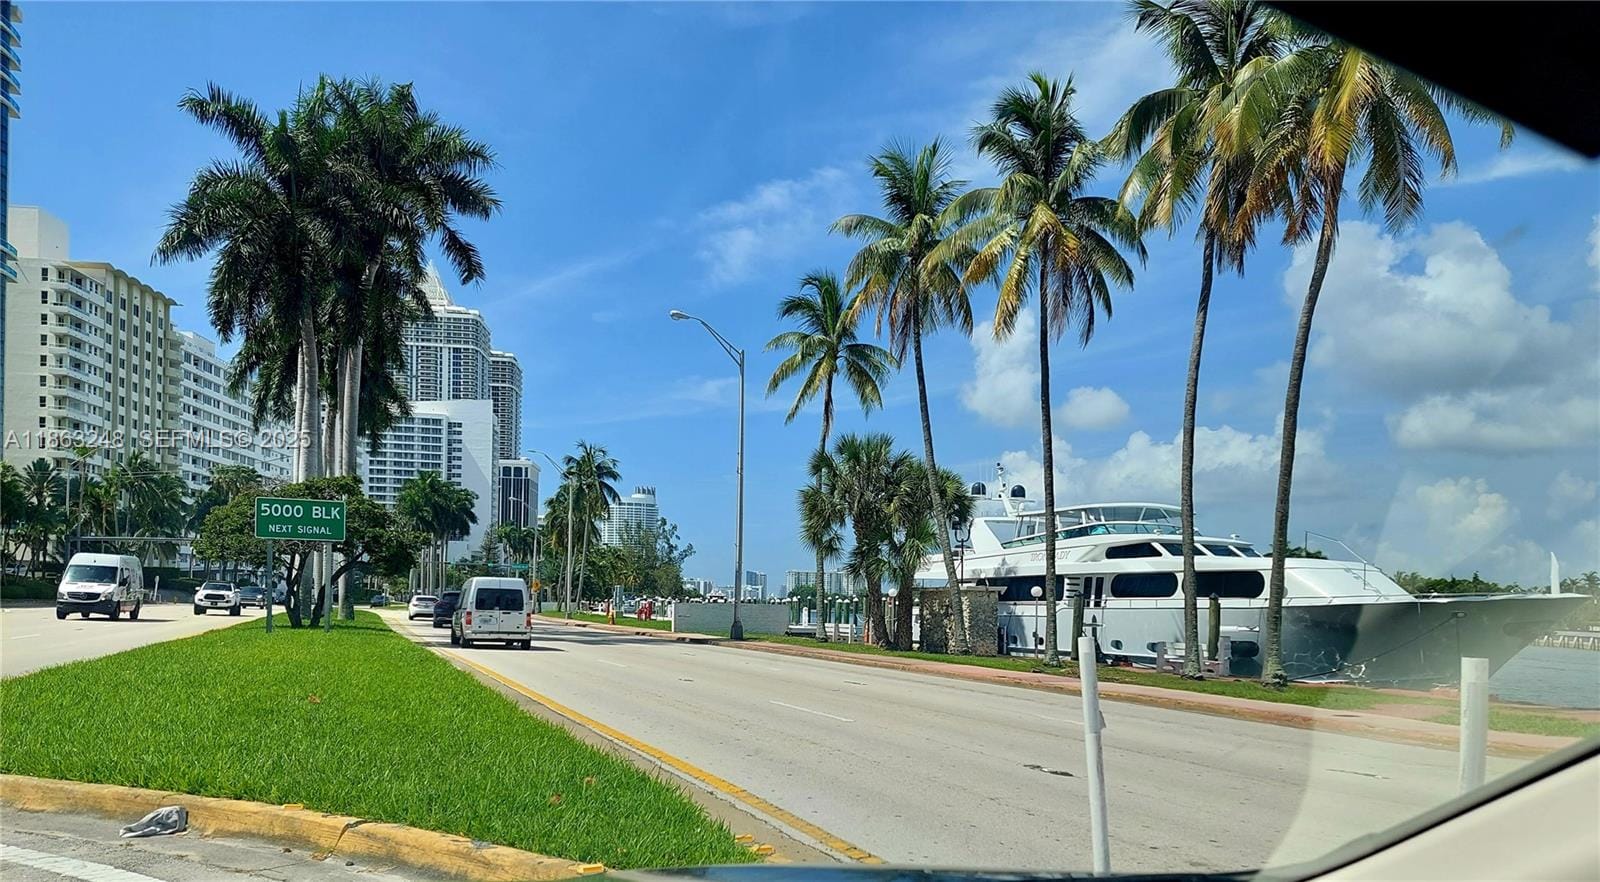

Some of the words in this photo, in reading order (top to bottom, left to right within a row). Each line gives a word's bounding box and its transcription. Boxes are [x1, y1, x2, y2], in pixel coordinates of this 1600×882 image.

[260, 503, 303, 517] 5000
[312, 506, 341, 519] BLK
[268, 524, 293, 533] NEXT
[297, 525, 332, 535] SIGNAL
